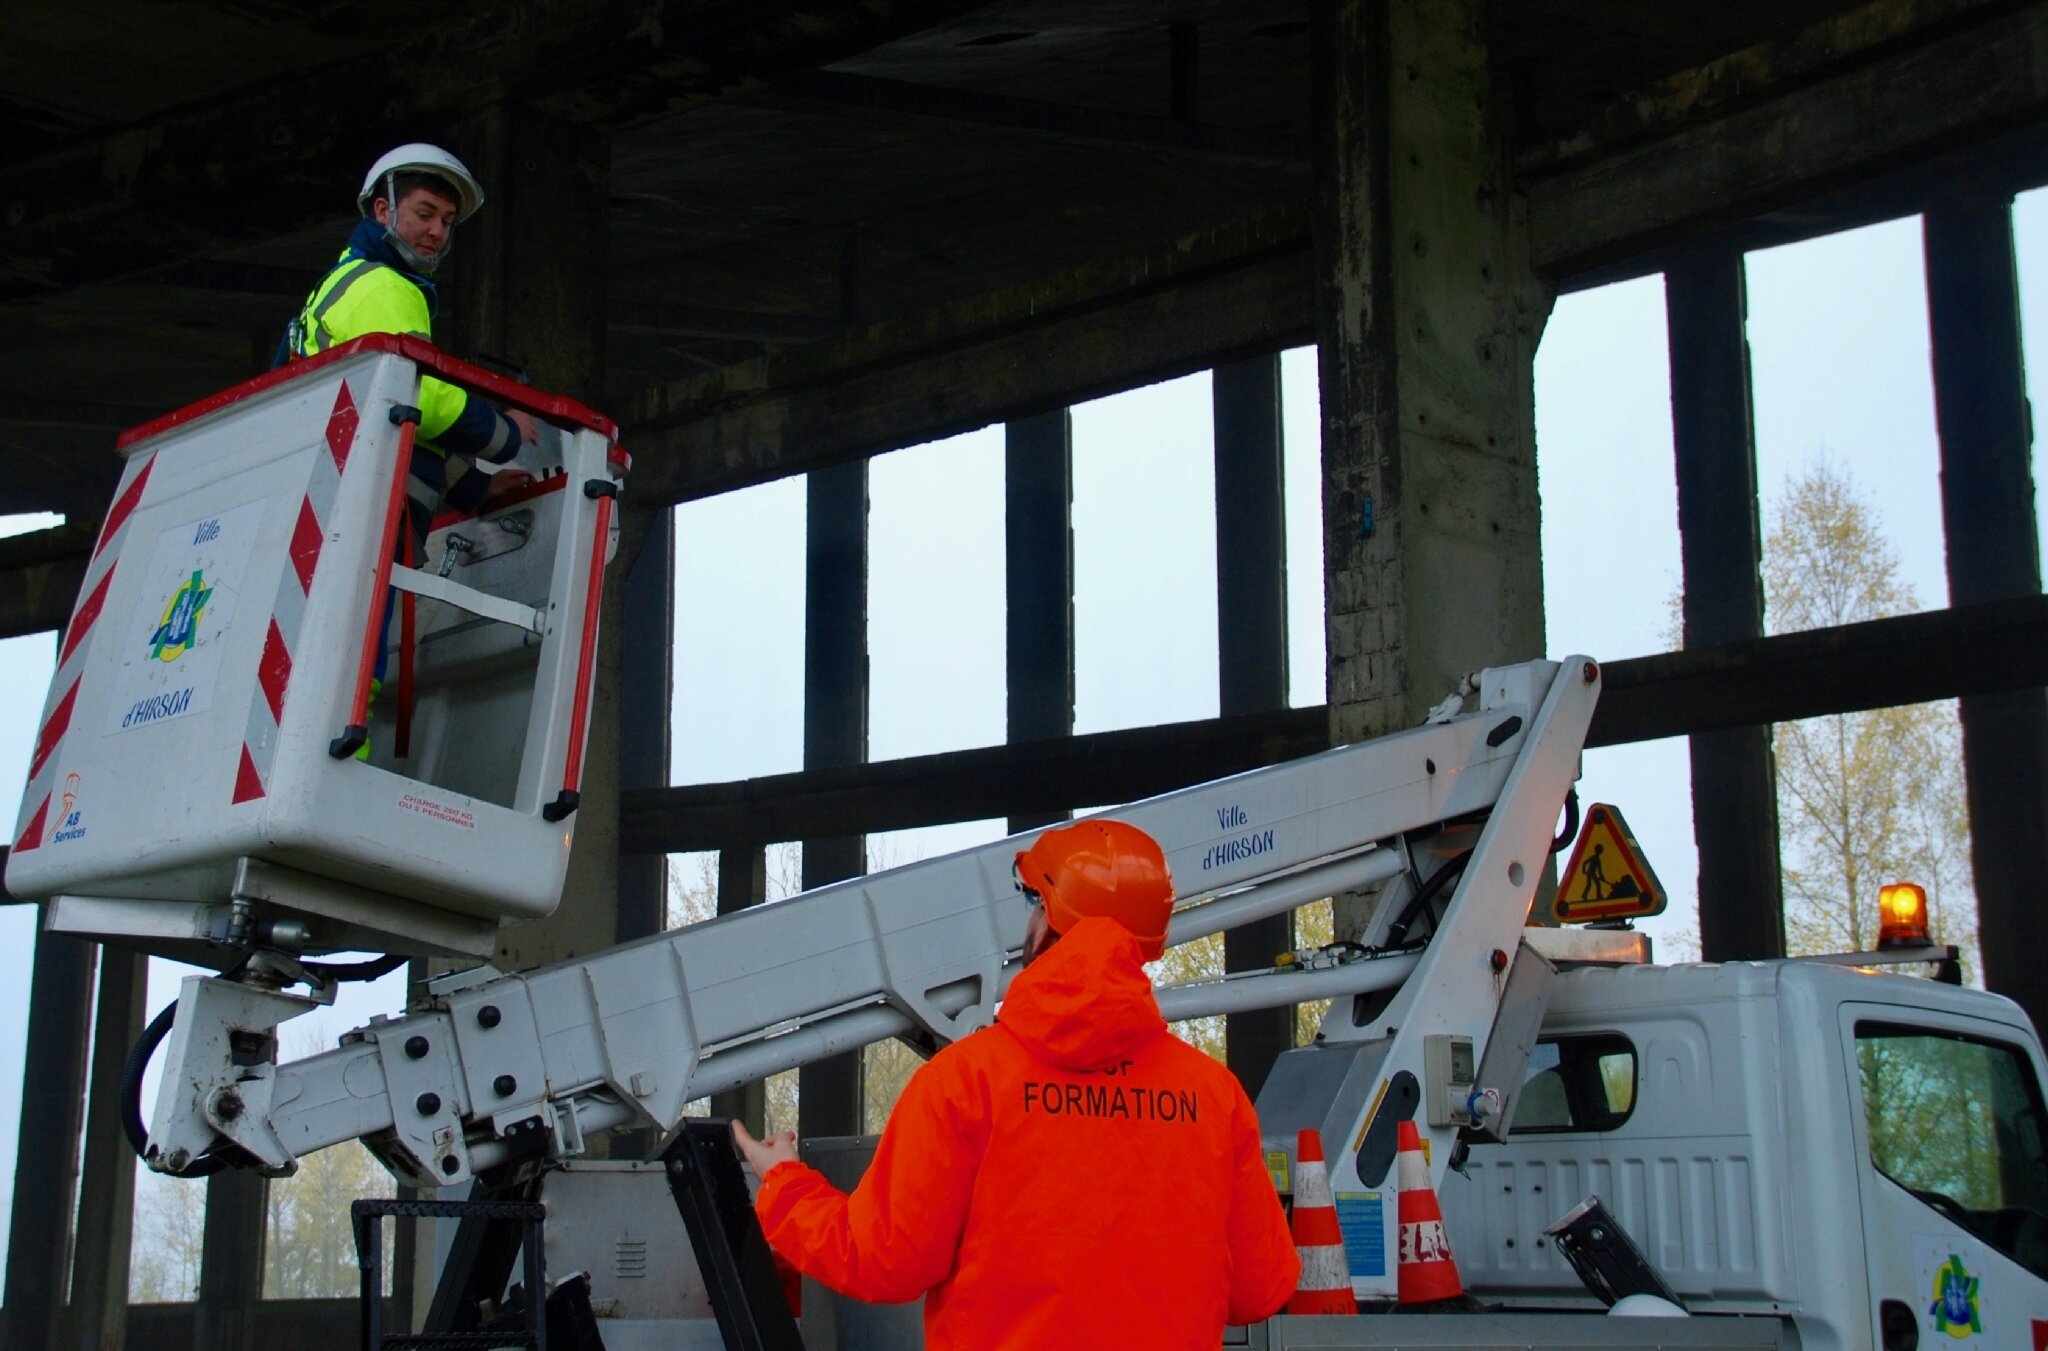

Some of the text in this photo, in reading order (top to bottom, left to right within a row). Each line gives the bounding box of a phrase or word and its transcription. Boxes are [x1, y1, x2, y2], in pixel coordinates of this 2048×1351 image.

[193, 518, 220, 546] Ville
[398, 801, 412, 809] OU
[422, 809, 475, 829] PERSONNES
[403, 794, 441, 810] CHARGE
[65, 811, 81, 827] AB
[1217, 805, 1248, 830] Ville
[54, 827, 86, 844] Services
[1203, 829, 1273, 870] d'HIRSON
[1024, 1082, 1198, 1123] FORMATION
